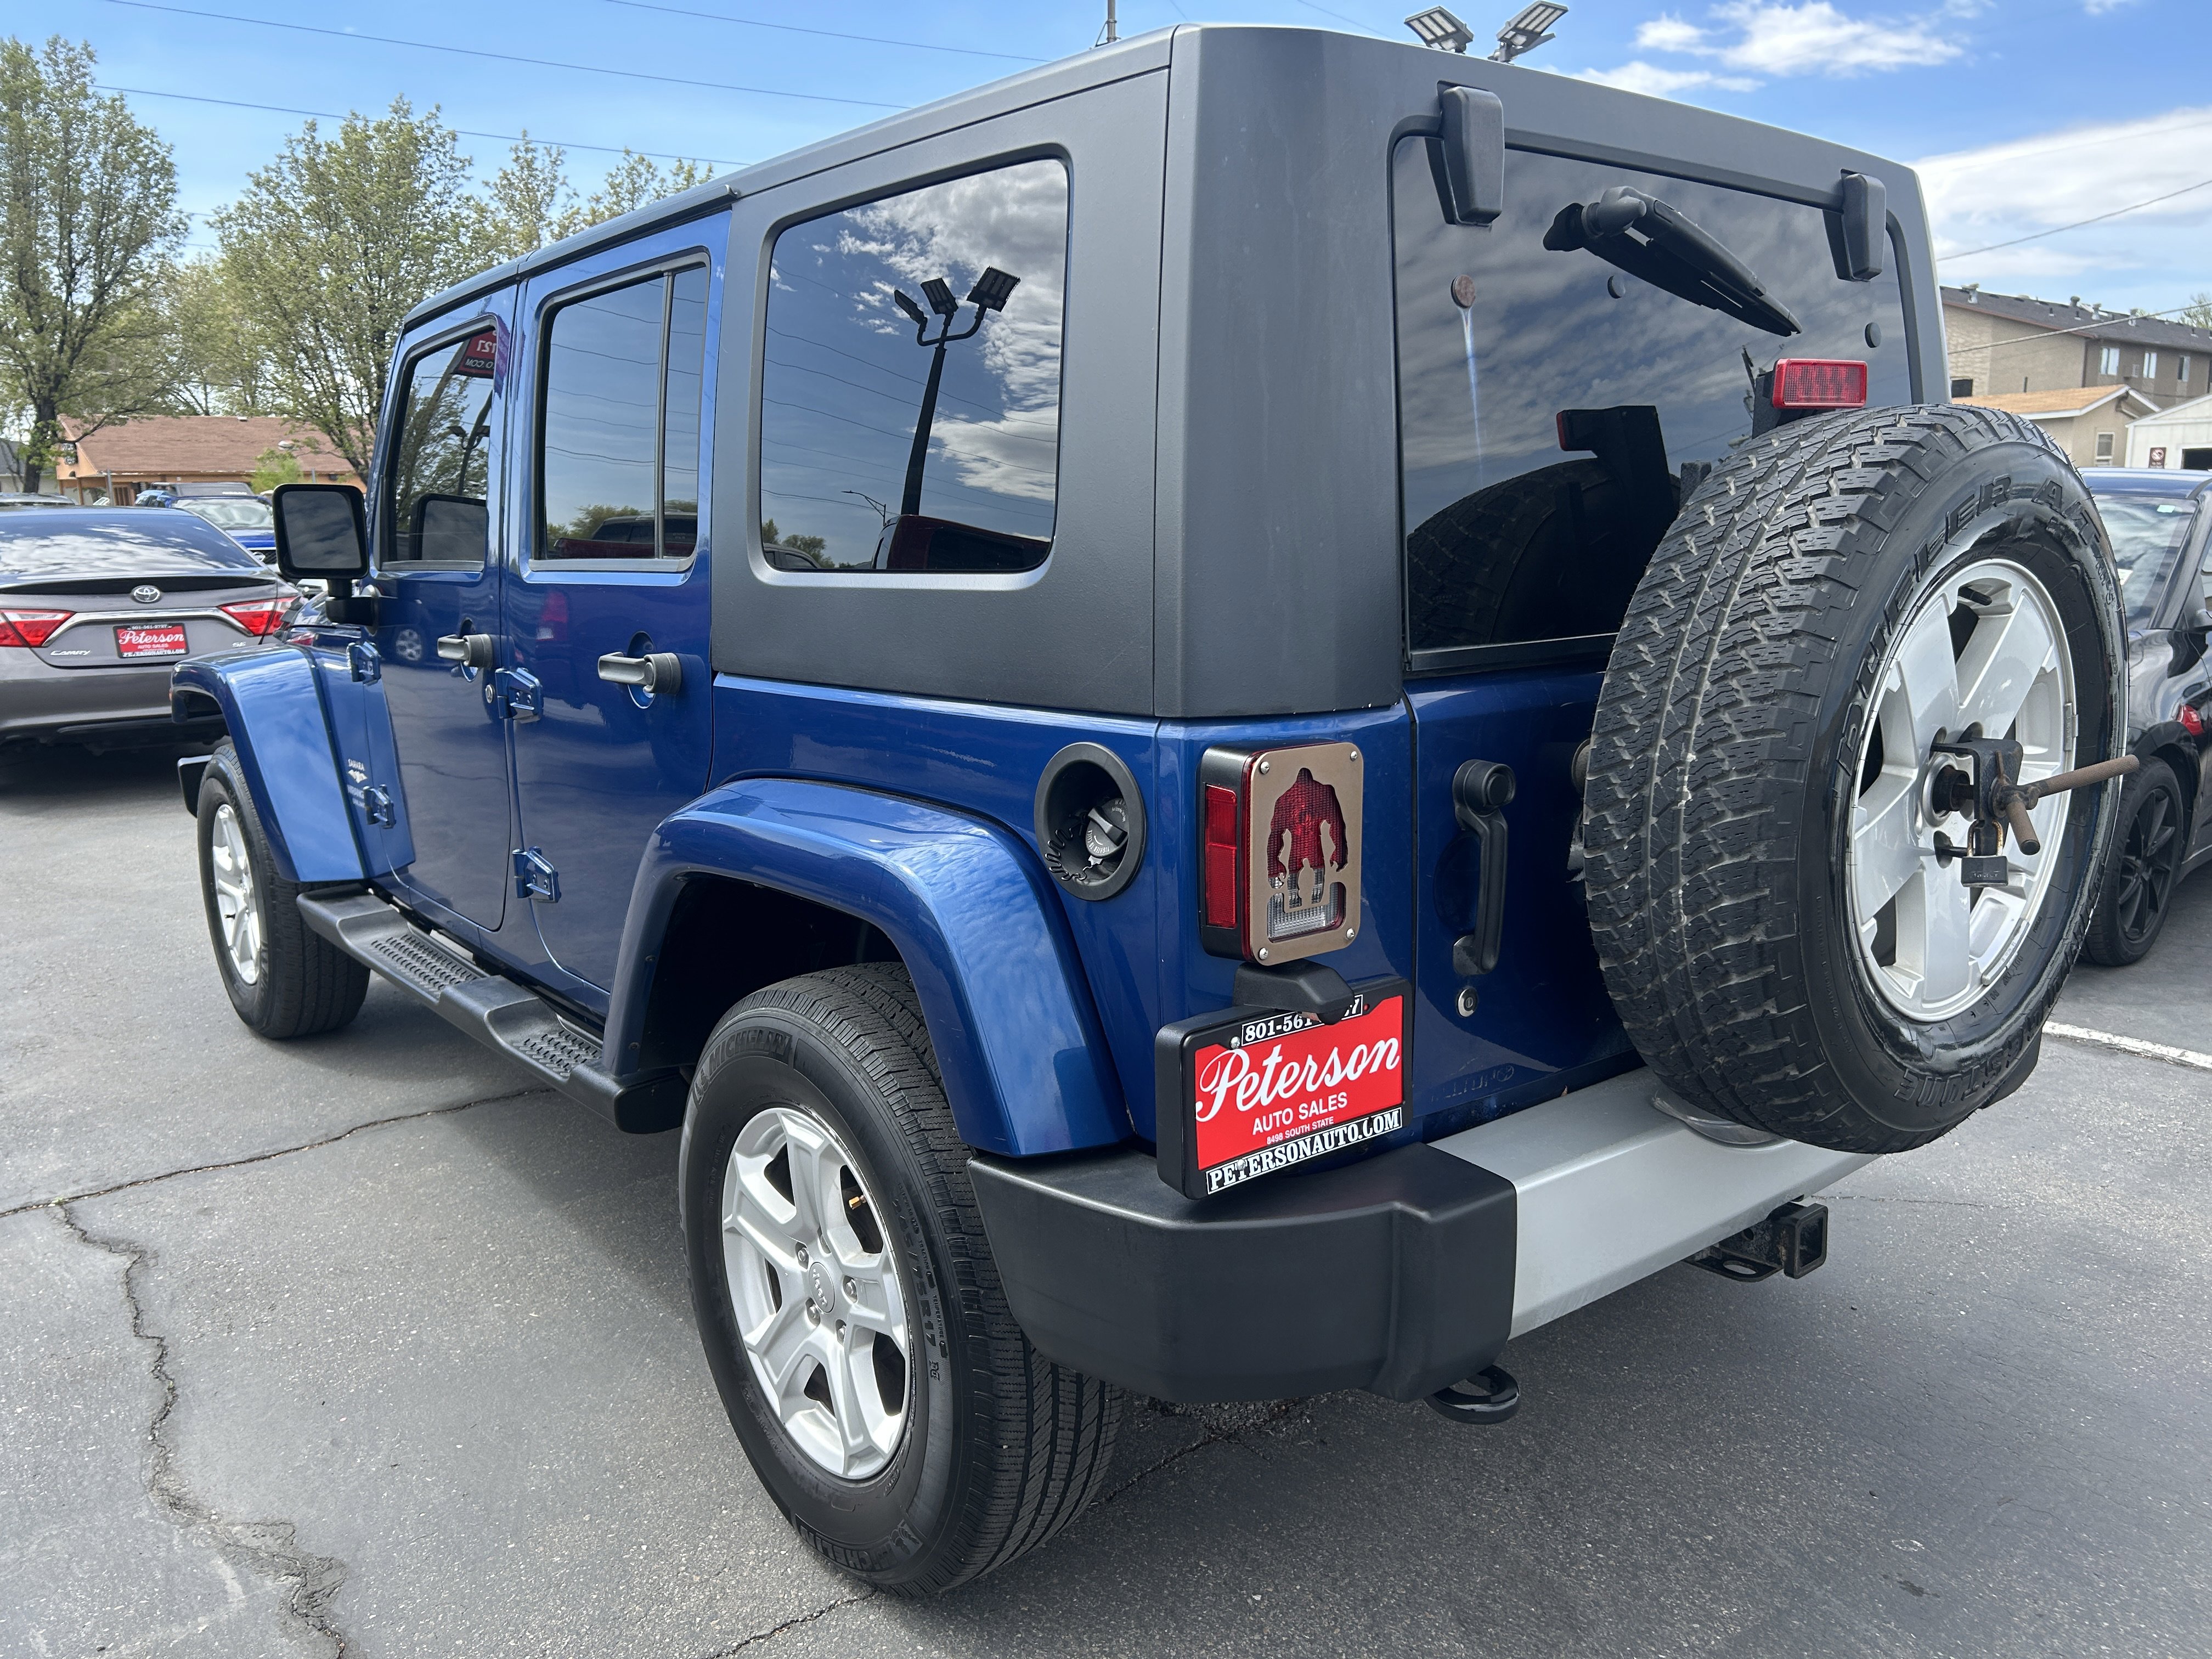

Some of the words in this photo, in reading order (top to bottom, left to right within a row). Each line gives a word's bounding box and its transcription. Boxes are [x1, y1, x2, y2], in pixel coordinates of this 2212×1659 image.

[119, 630, 184, 645] Peterson
[1836, 473, 2012, 776] DUELER
[708, 1029, 791, 1077] MICHELIN
[1195, 1037, 1400, 1122] Peterson
[1251, 1108, 1294, 1136] AUTO
[1298, 1092, 1348, 1119] SALES
[1266, 1132, 1283, 1145] 8498
[1284, 1123, 1311, 1139] SOUTH
[1312, 1116, 1334, 1130] STATE
[1209, 1110, 1400, 1191] PETERSONAUTO.COM
